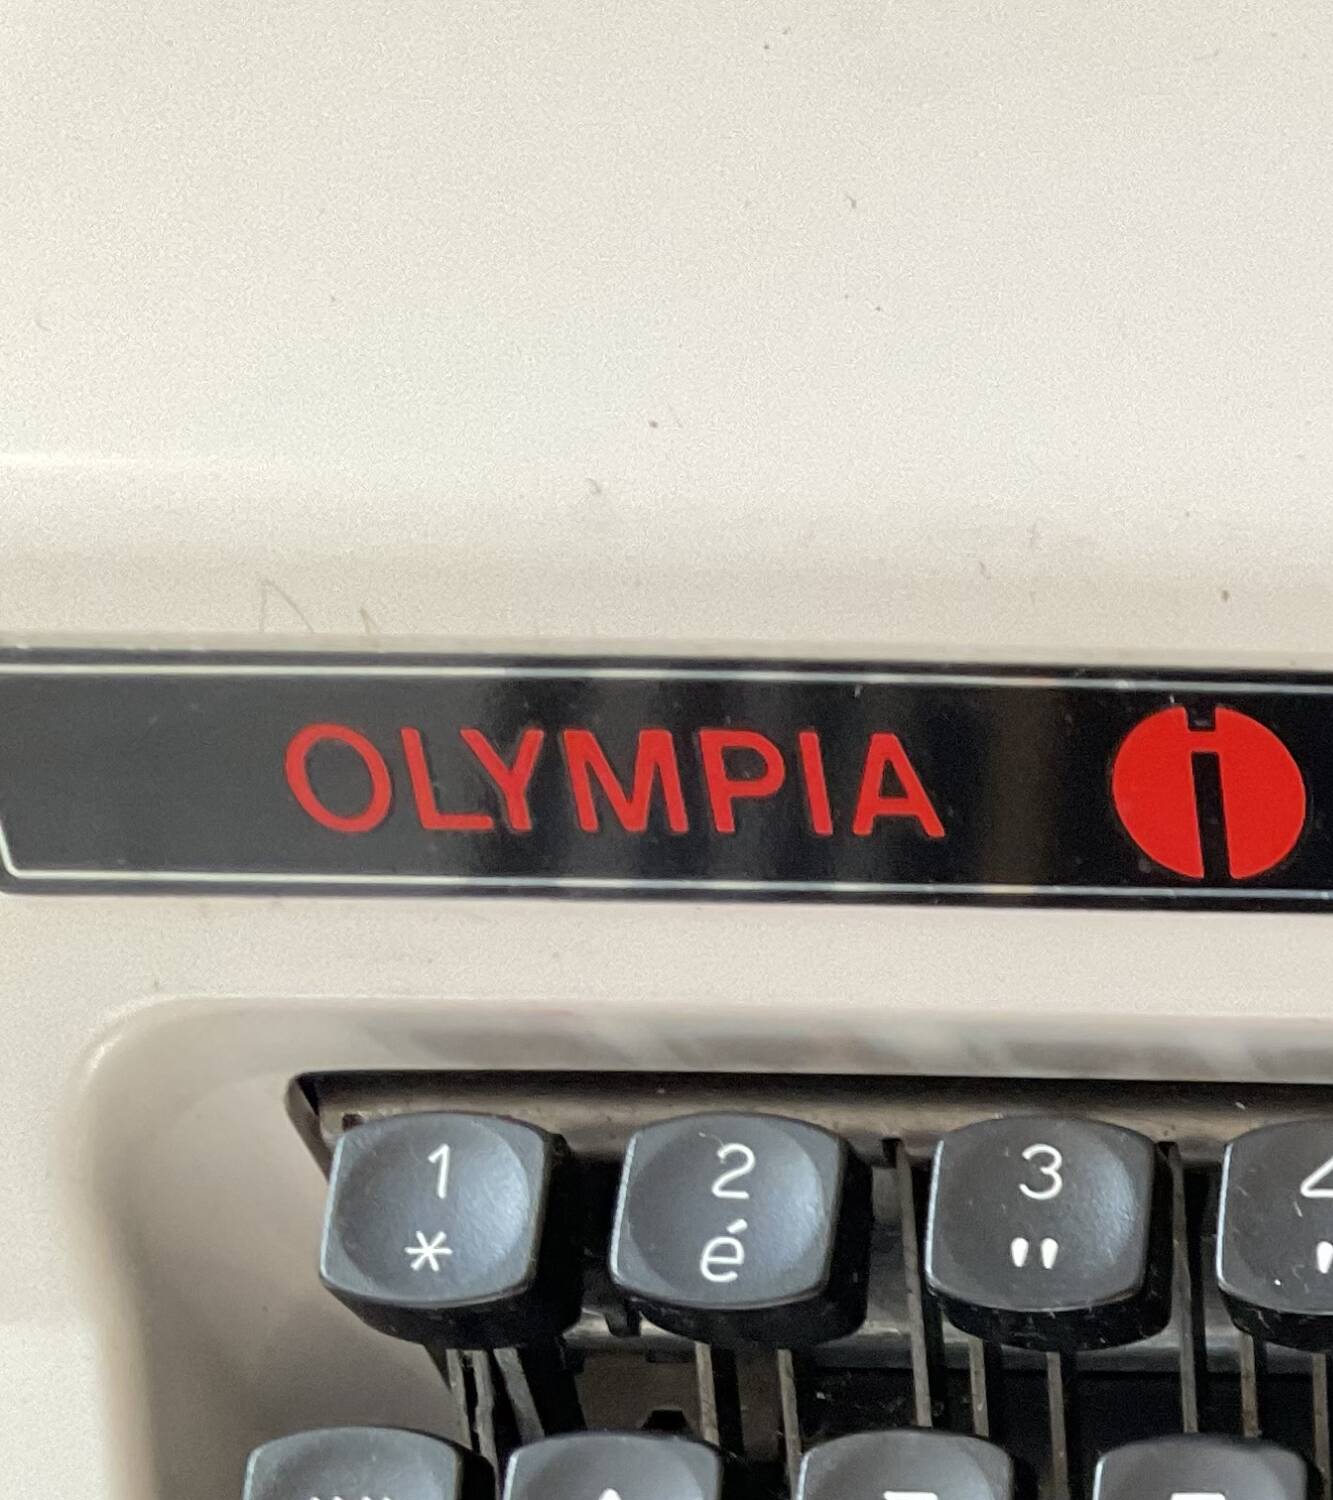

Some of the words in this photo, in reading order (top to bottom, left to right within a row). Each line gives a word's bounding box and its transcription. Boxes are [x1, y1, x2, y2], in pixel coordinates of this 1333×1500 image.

[285, 724, 944, 837] OLYMPIA
[428, 1144, 450, 1199] 1
[711, 1143, 755, 1200] 2
[1019, 1144, 1063, 1200] 3
[700, 1218, 748, 1283] é
